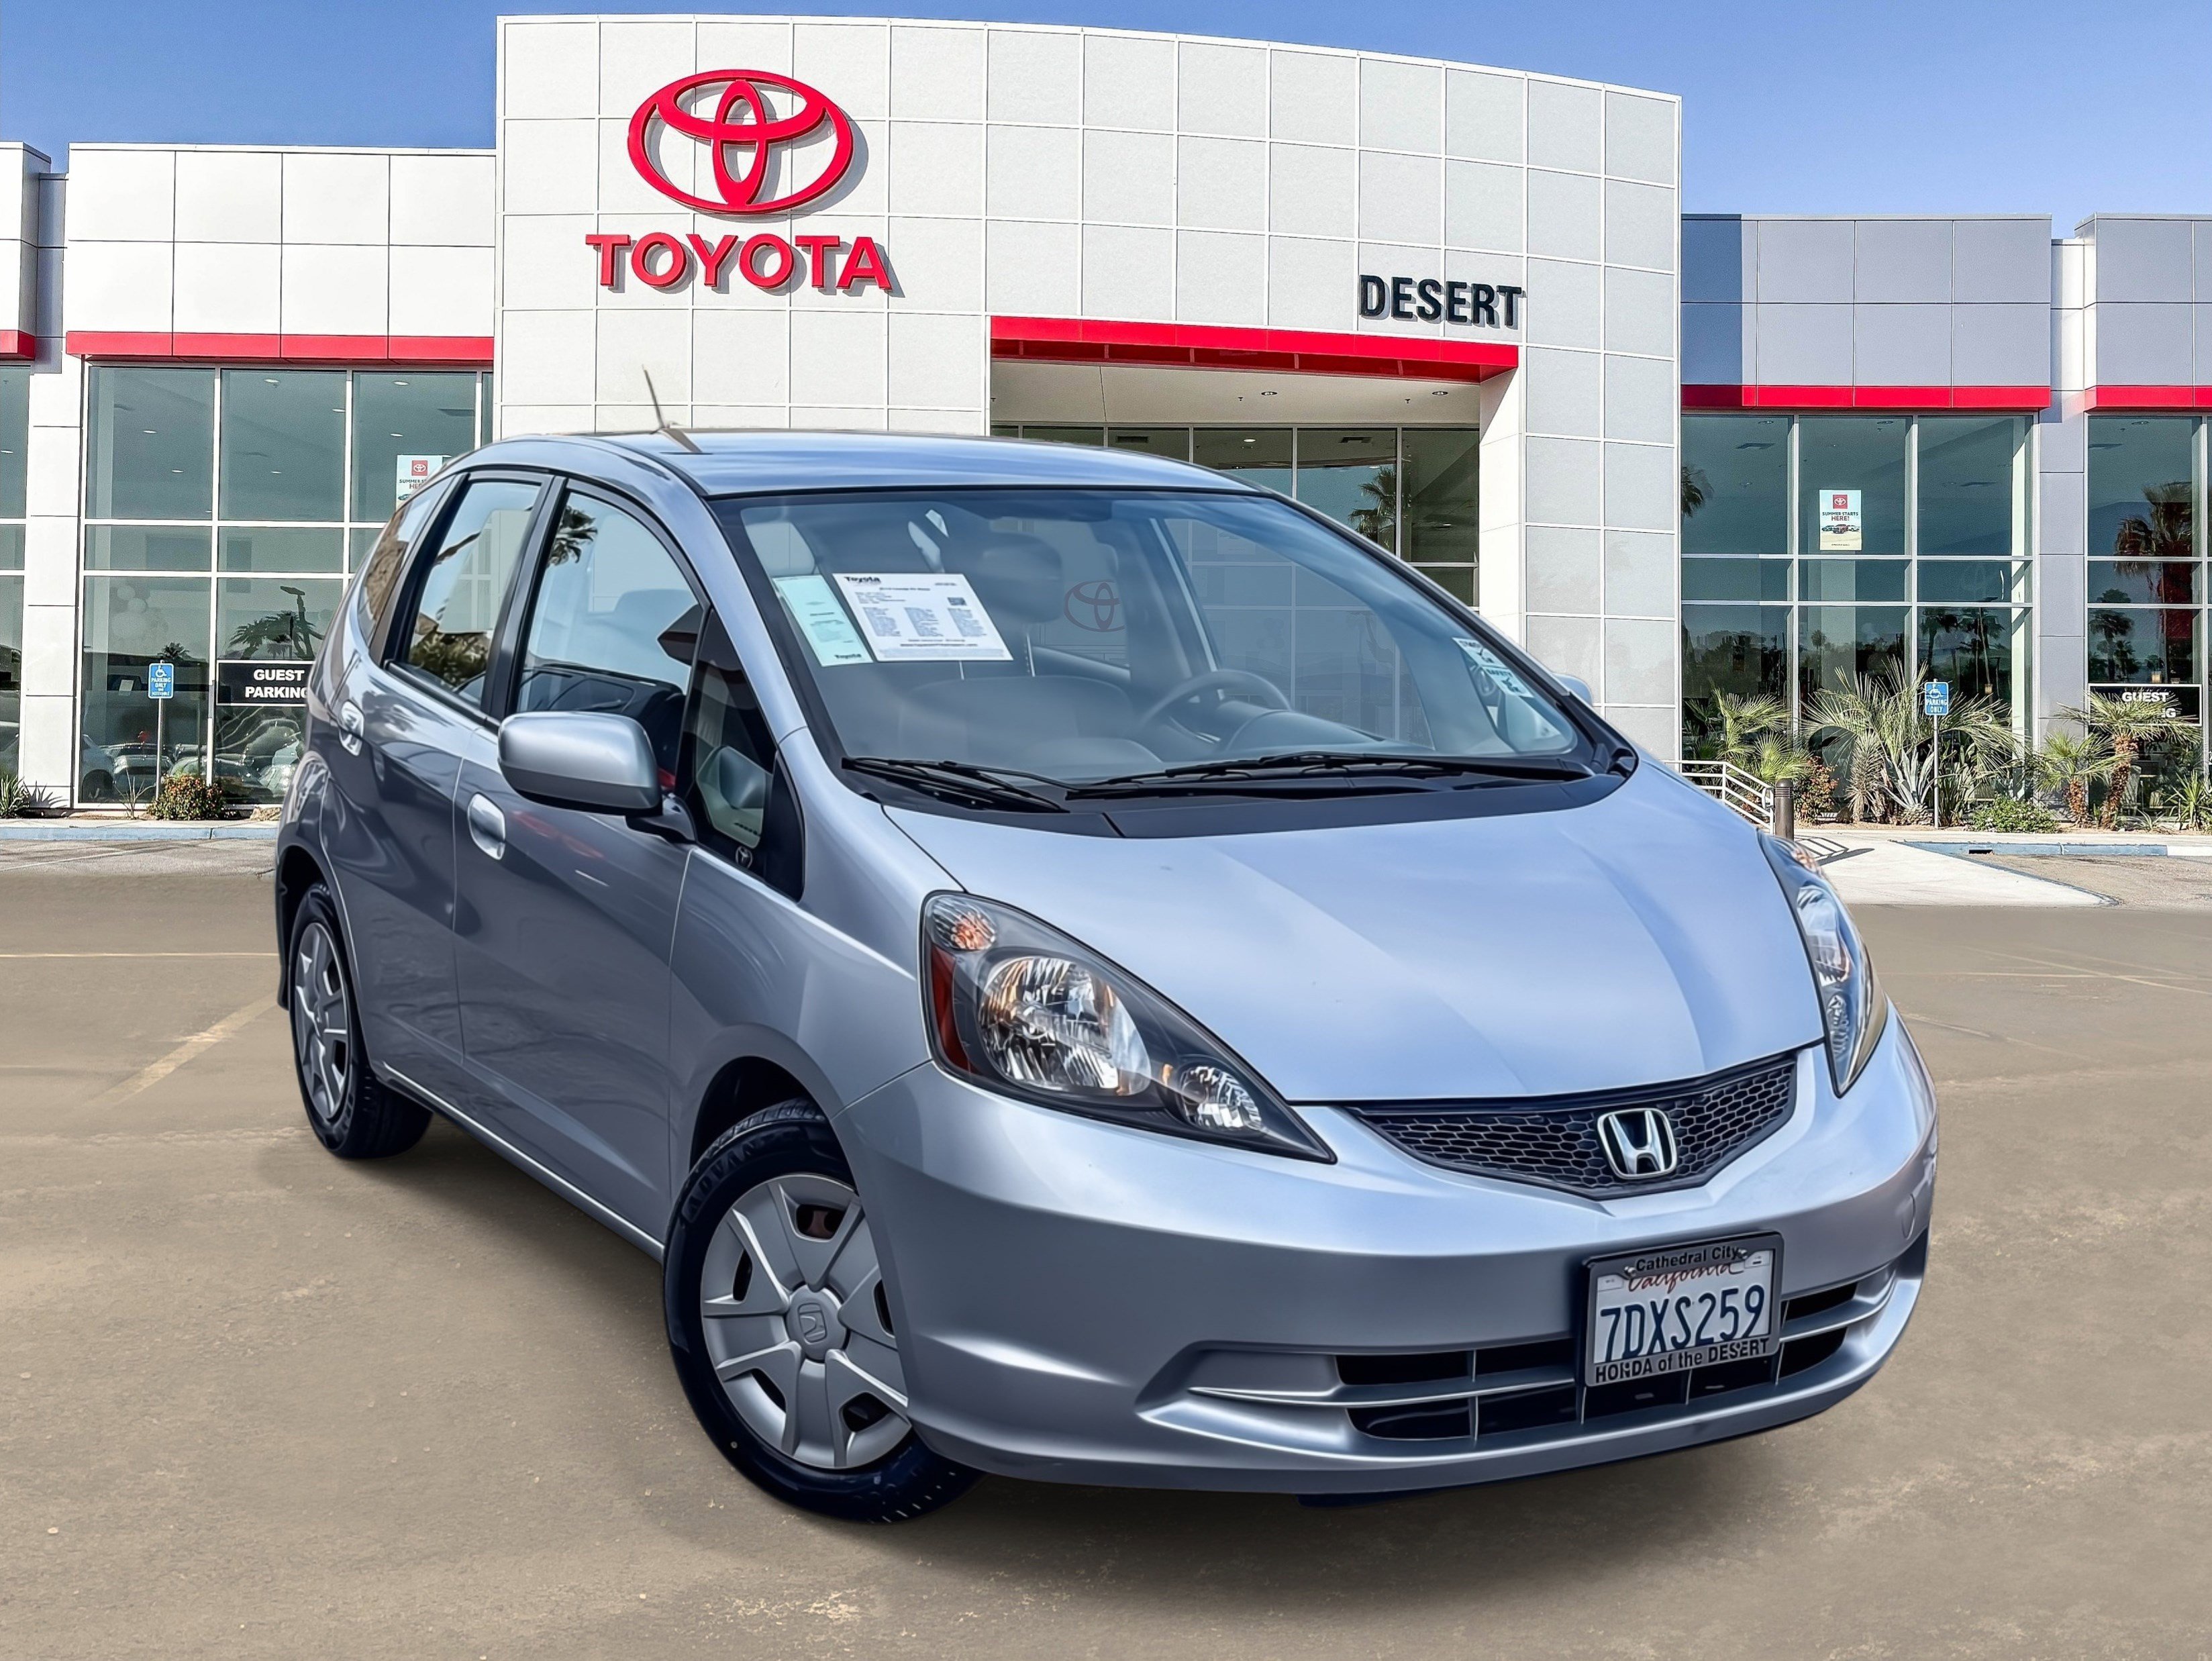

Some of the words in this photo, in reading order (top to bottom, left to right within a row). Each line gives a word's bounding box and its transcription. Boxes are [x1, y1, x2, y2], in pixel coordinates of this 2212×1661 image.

[586, 232, 893, 291] TOYOTA
[1359, 274, 1522, 326] DESERT
[253, 668, 305, 681] GUEST
[1930, 705, 1944, 713] ONLY
[2121, 691, 2170, 703] GUEST
[1636, 1249, 1708, 1272] Cathedral
[1711, 1245, 1740, 1262] City
[1600, 1284, 1765, 1363] 7DXS259
[1595, 1360, 1654, 1384] HONDA
[1658, 1354, 1674, 1372] of
[1678, 1348, 1703, 1370] the
[1708, 1338, 1769, 1364] DESERT
